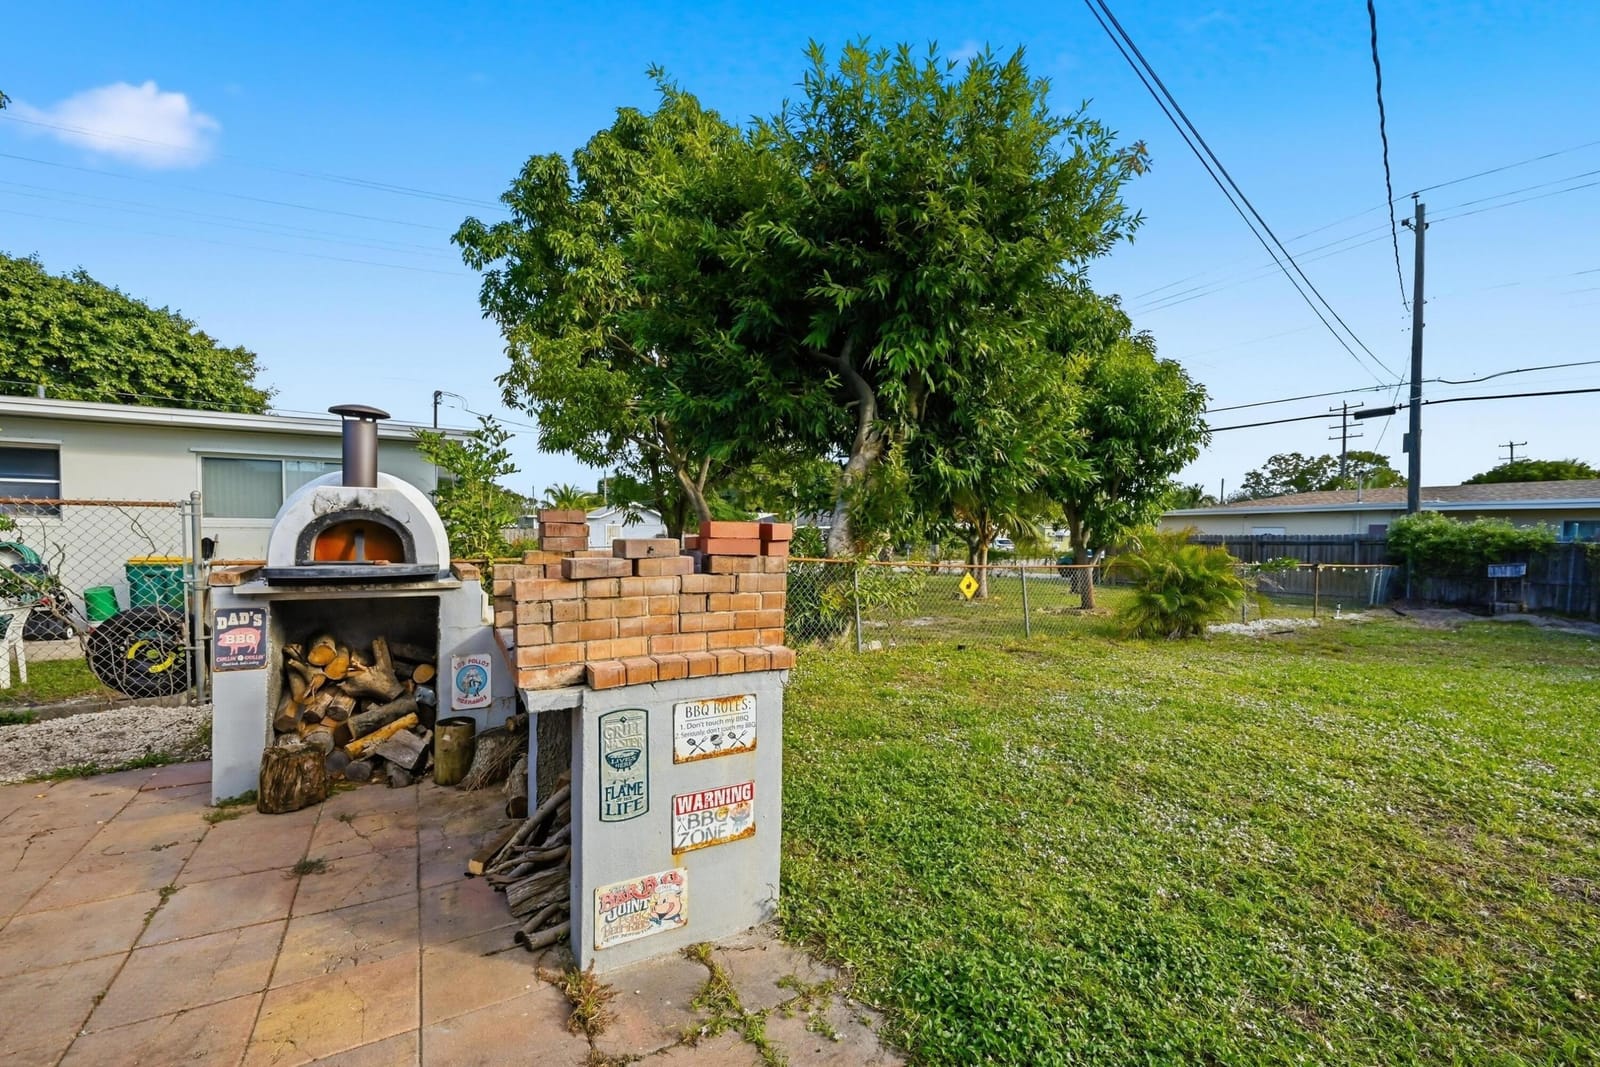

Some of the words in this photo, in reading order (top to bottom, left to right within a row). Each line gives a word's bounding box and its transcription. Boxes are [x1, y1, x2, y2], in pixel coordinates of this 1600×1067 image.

[216, 611, 262, 629] DAD'S
[225, 634, 257, 644] BBQ
[453, 661, 465, 670] LOS
[467, 658, 489, 667] POLLOS
[685, 704, 710, 719] BBQ
[686, 721, 705, 730] Don't
[705, 718, 724, 727] touch
[735, 714, 749, 722] BBQ
[605, 781, 644, 802] FLAME
[677, 784, 751, 814] WARNING
[605, 796, 644, 815] LIFE
[678, 823, 728, 848] ZONE
[605, 897, 651, 923] JOINT
